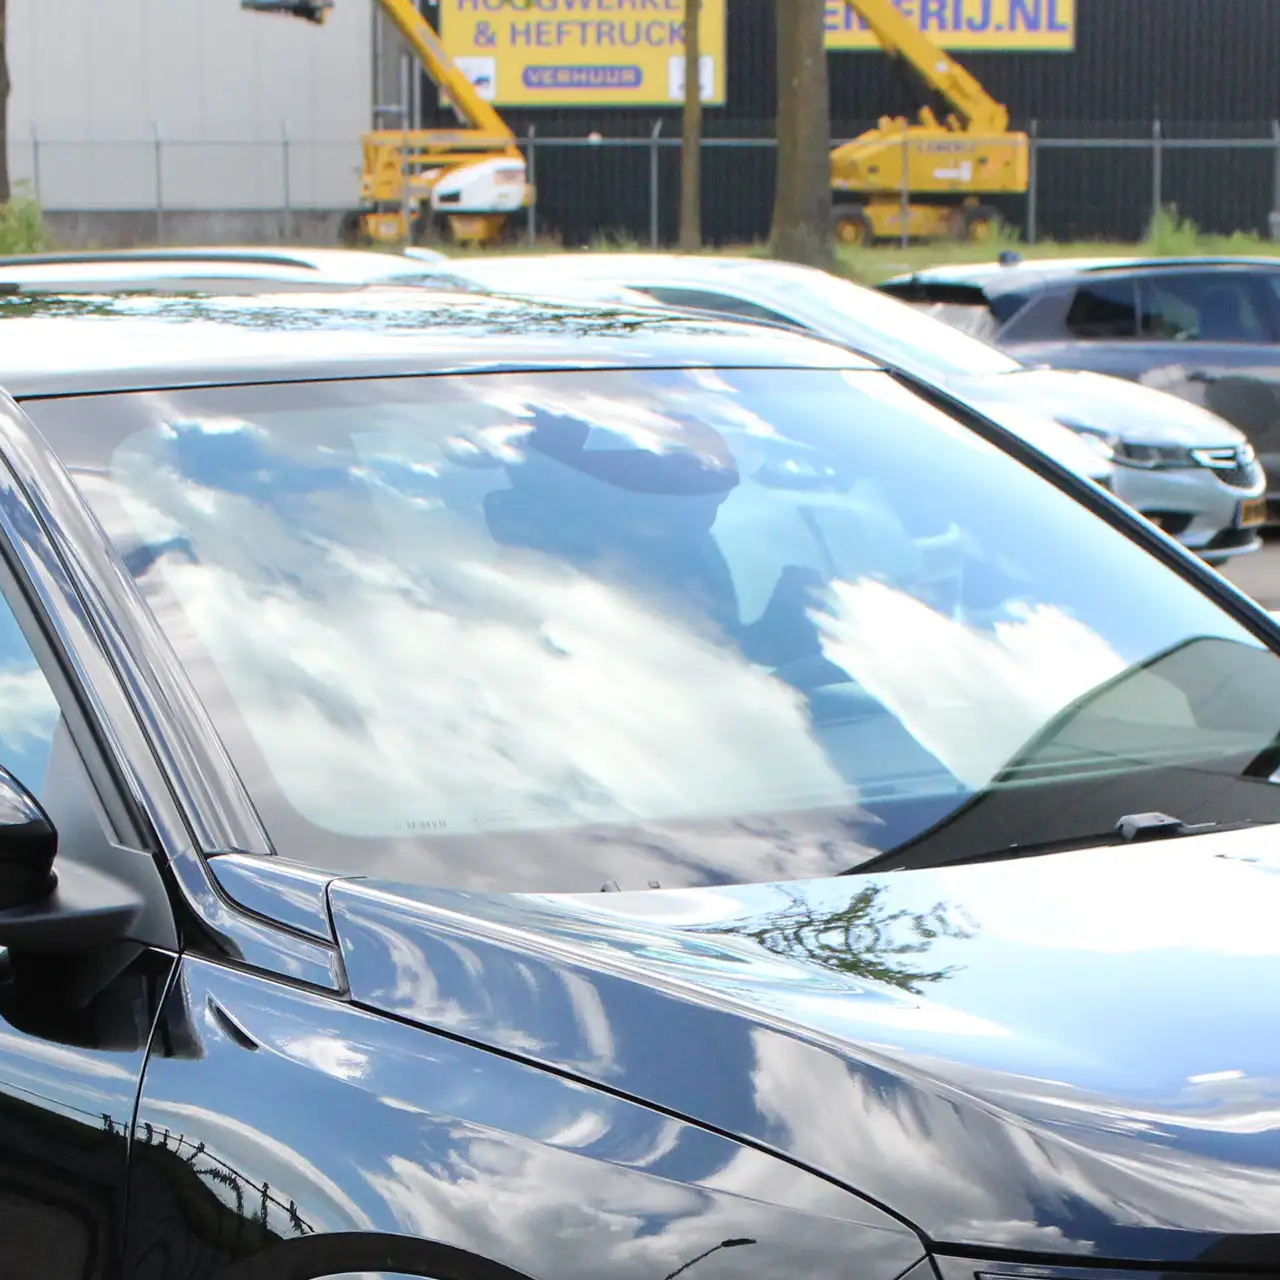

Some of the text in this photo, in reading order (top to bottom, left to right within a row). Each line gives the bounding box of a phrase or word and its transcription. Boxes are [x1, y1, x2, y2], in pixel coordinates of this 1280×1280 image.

[473, 20, 686, 47] & HEFTRUCK
[526, 67, 637, 84] VERHUUR
